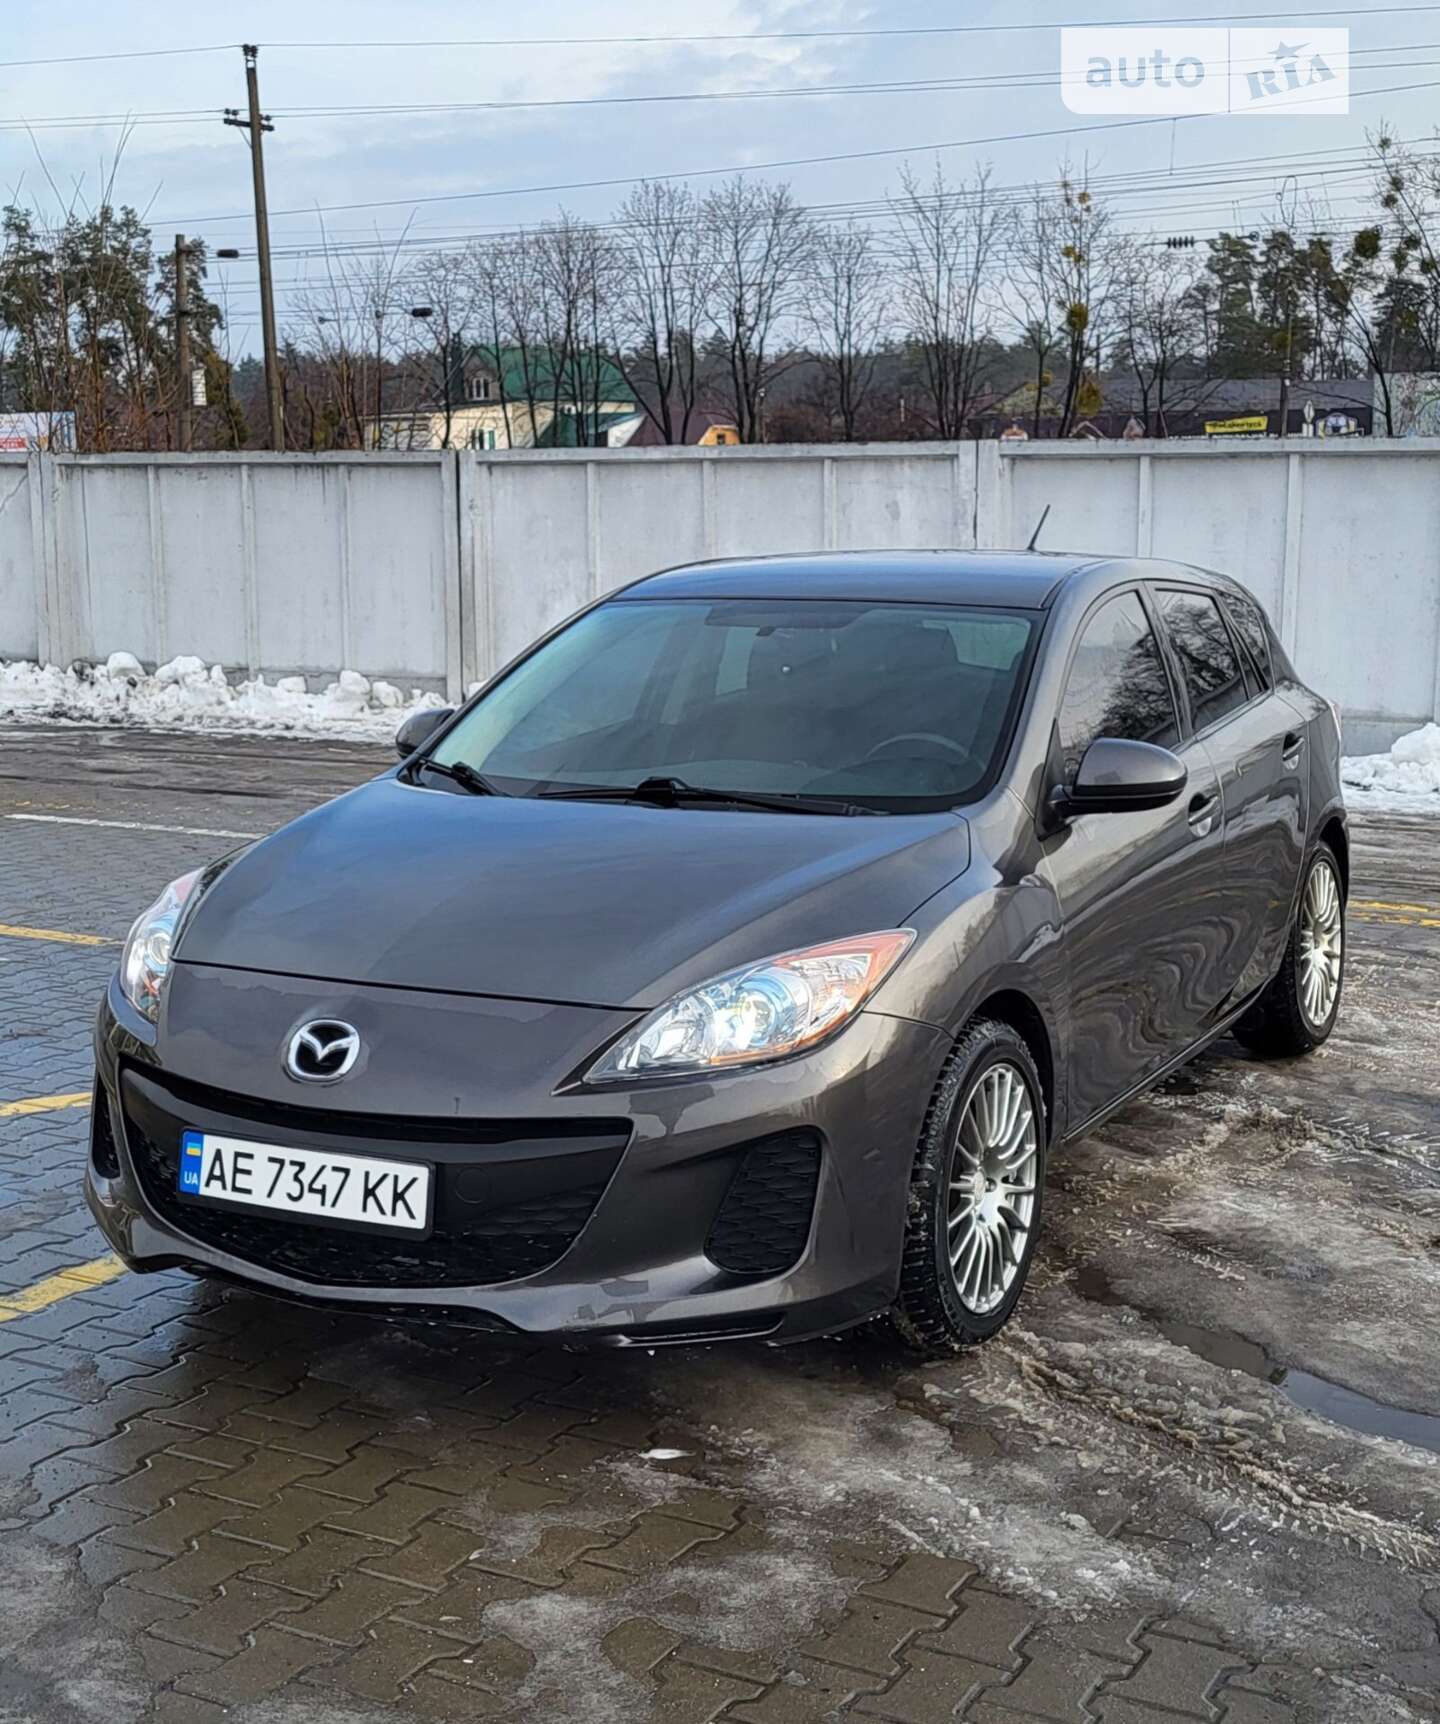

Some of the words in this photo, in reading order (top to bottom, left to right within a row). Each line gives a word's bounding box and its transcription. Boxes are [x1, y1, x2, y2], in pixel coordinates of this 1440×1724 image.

[184, 1171, 199, 1186] UA
[204, 1148, 254, 1195] AE
[266, 1156, 351, 1208] 7347
[361, 1170, 419, 1220] KK
